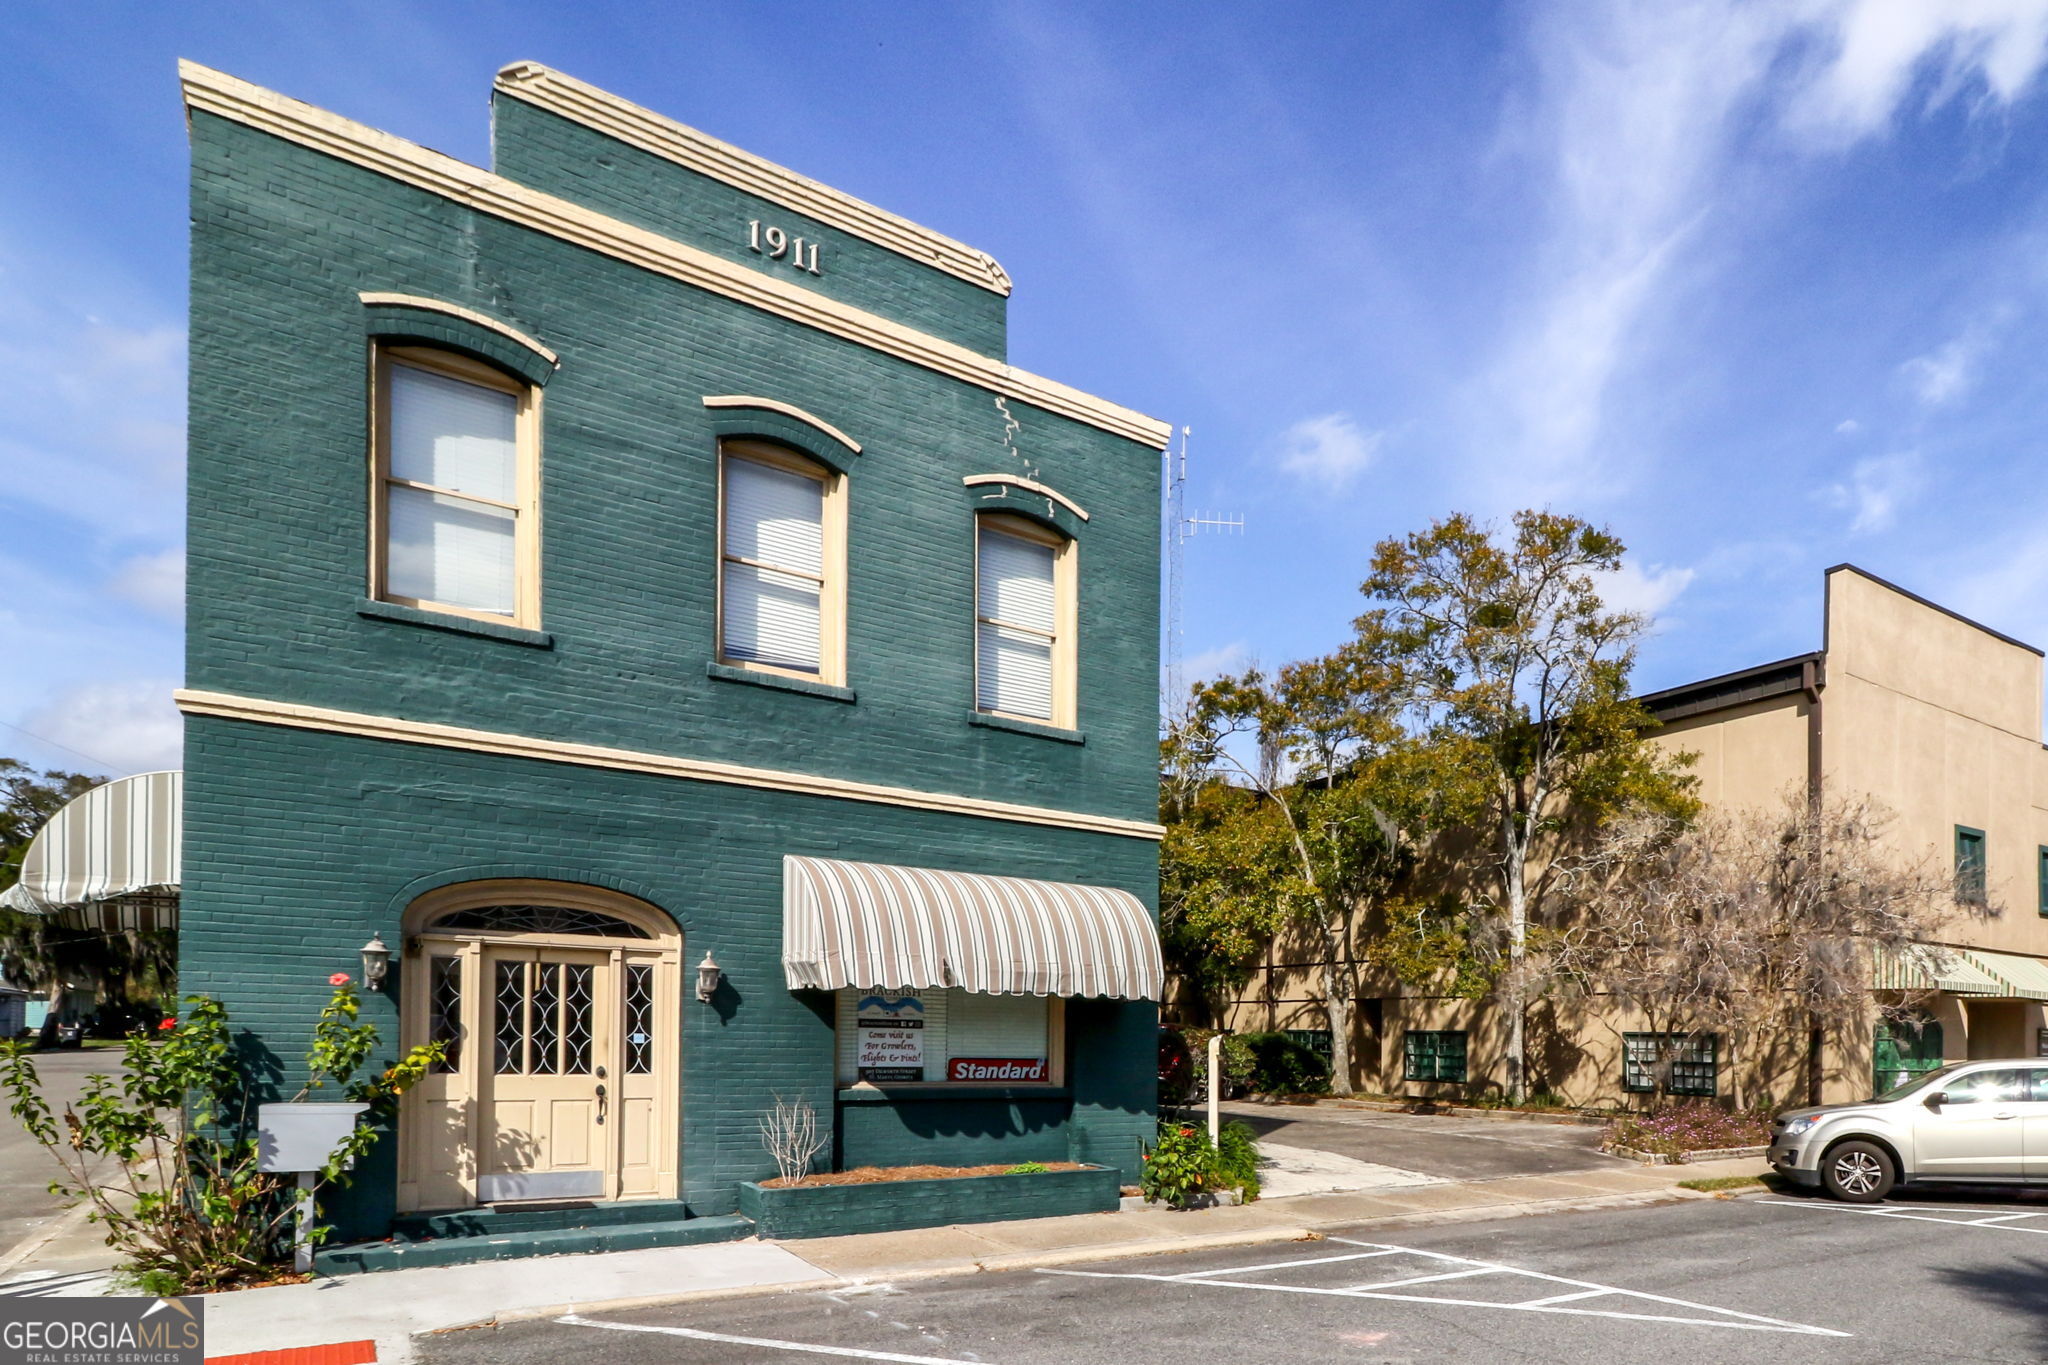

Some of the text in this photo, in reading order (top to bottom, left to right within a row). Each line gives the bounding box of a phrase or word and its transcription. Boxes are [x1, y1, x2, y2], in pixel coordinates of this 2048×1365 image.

[746, 219, 821, 275] 1911
[868, 1031, 886, 1039] Come
[889, 1031, 904, 1039] visit
[865, 1040, 916, 1051] For Growlers,
[861, 1051, 887, 1066] Flights
[889, 1054, 899, 1062] &
[954, 1062, 1041, 1079] Standard
